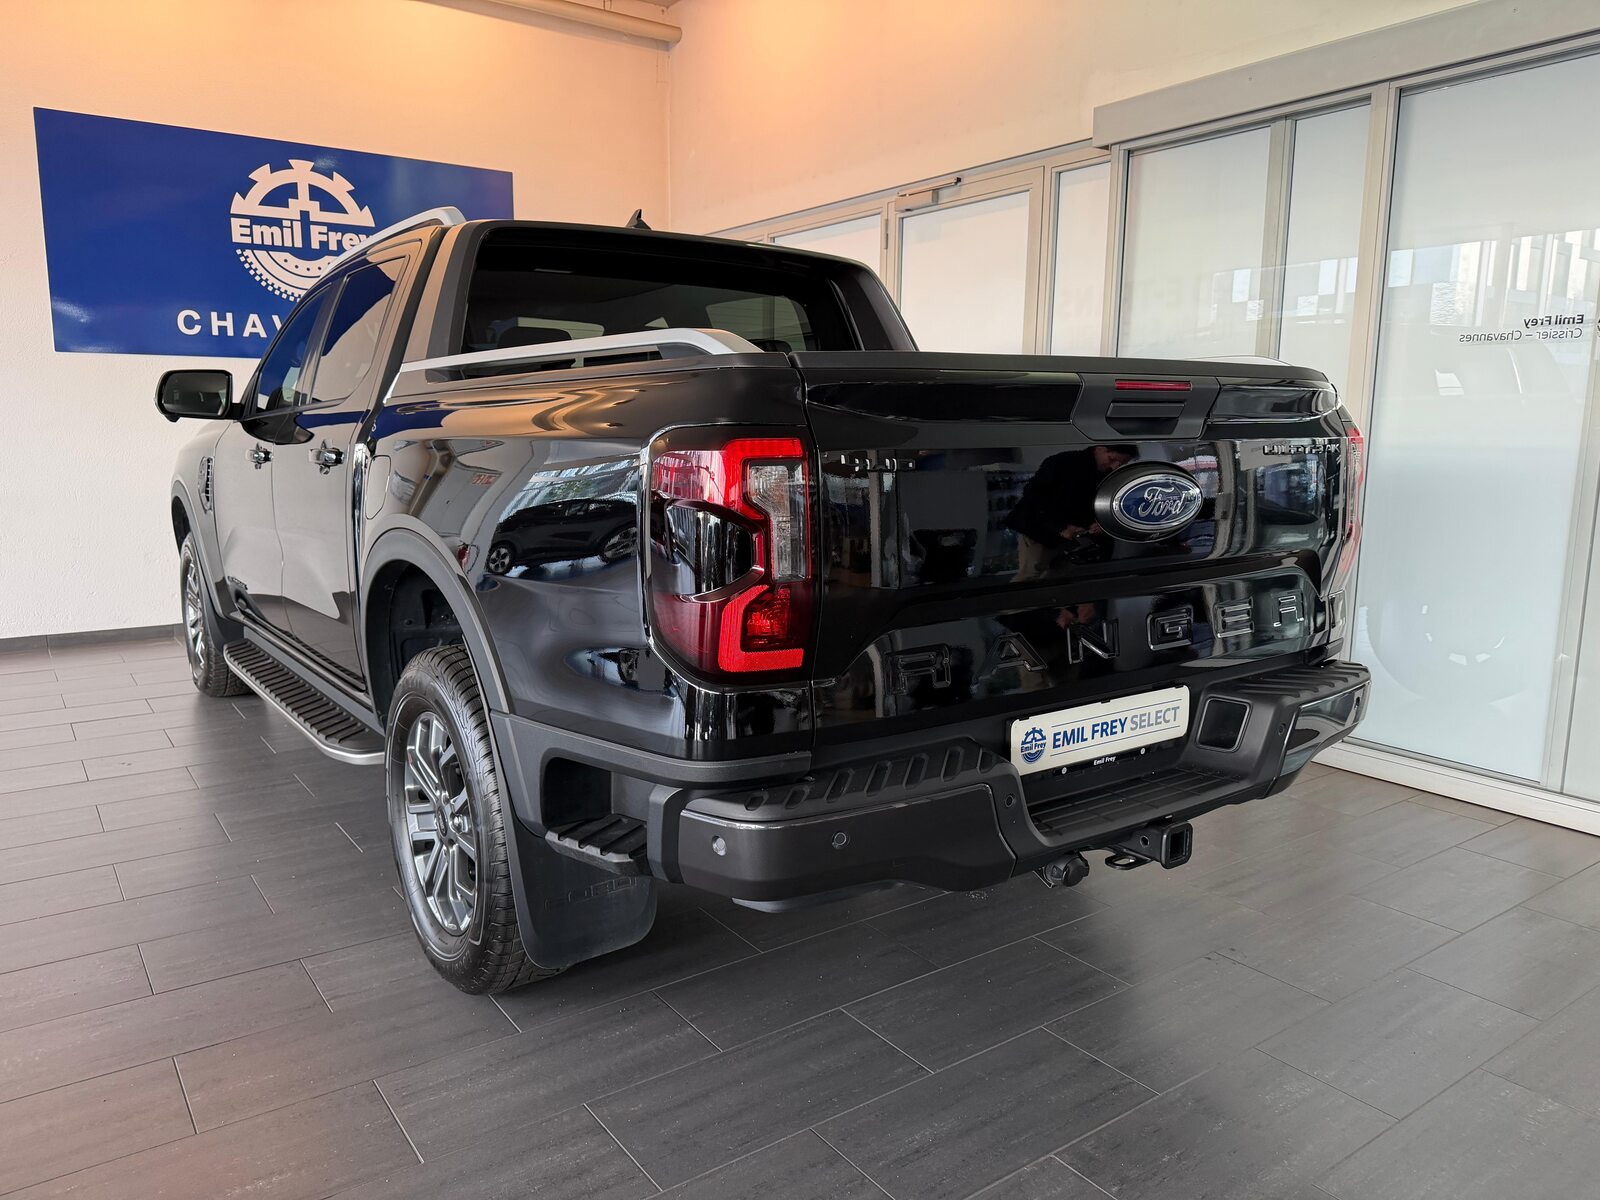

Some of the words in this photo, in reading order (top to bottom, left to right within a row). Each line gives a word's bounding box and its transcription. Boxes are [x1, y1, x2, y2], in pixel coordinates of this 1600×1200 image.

[231, 217, 302, 248] Emil
[1138, 486, 1185, 517] Ford
[887, 589, 1306, 695] RANGER
[1052, 727, 1088, 749] EMIL
[1091, 717, 1128, 740] FREY
[1130, 706, 1180, 731] SELECT
[1021, 743, 1034, 753] Emil
[1034, 741, 1047, 750] Frey
[1093, 758, 1104, 766] Emil
[1105, 755, 1116, 763] Frey
